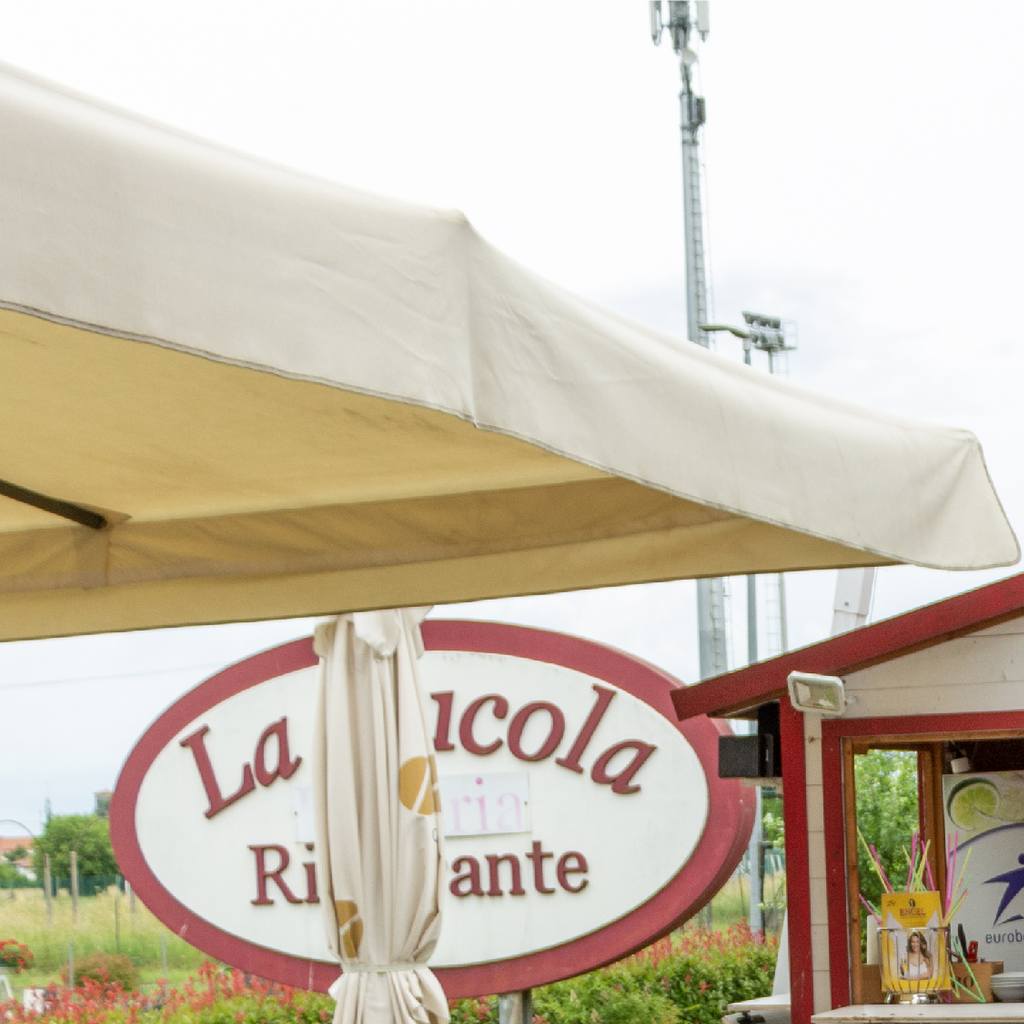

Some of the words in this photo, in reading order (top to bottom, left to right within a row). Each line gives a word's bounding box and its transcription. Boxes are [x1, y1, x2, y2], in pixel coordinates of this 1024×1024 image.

[180, 717, 302, 818] La
[431, 685, 656, 795] cola
[249, 842, 589, 906] Riante
